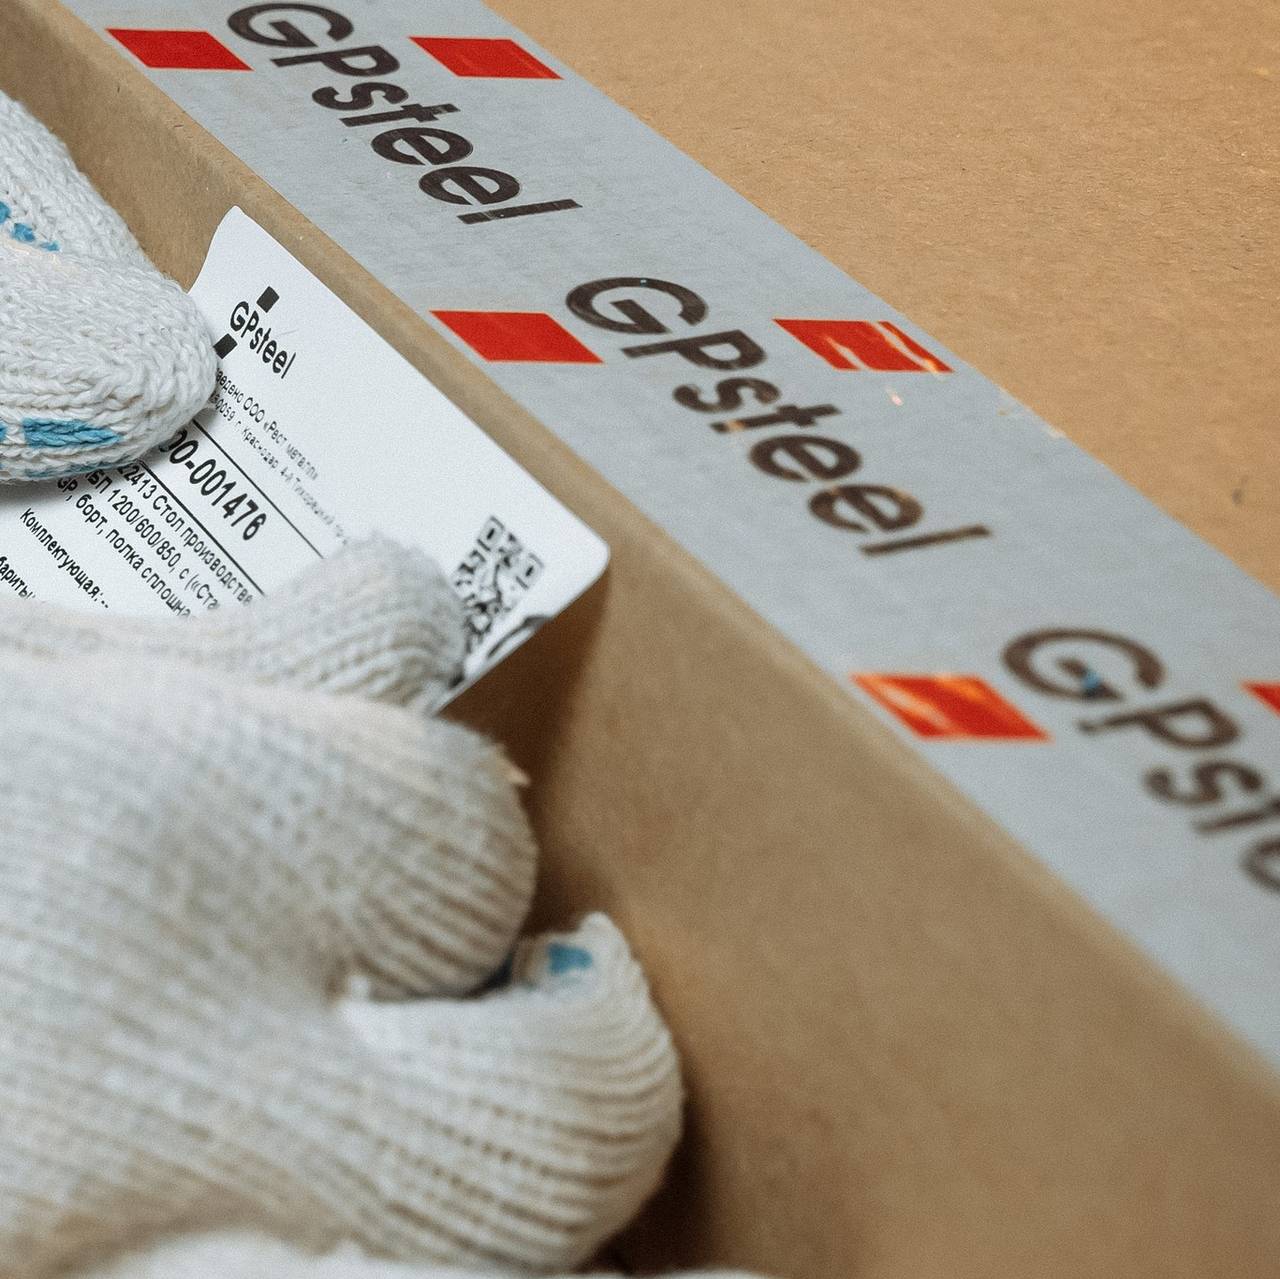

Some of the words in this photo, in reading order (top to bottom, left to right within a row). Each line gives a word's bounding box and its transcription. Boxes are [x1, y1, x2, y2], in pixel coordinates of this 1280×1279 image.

[226, 1, 583, 225] GPsteel
[564, 275, 992, 557] GPsteel
[228, 300, 297, 380] GPsteel
[17, 505, 104, 603] Комплектующая:
[73, 491, 109, 536] борт,
[103, 526, 146, 572] полка
[81, 467, 114, 496] БП
[105, 486, 183, 572] 1200/600/850,
[176, 566, 191, 581] с
[150, 492, 186, 533] Стол
